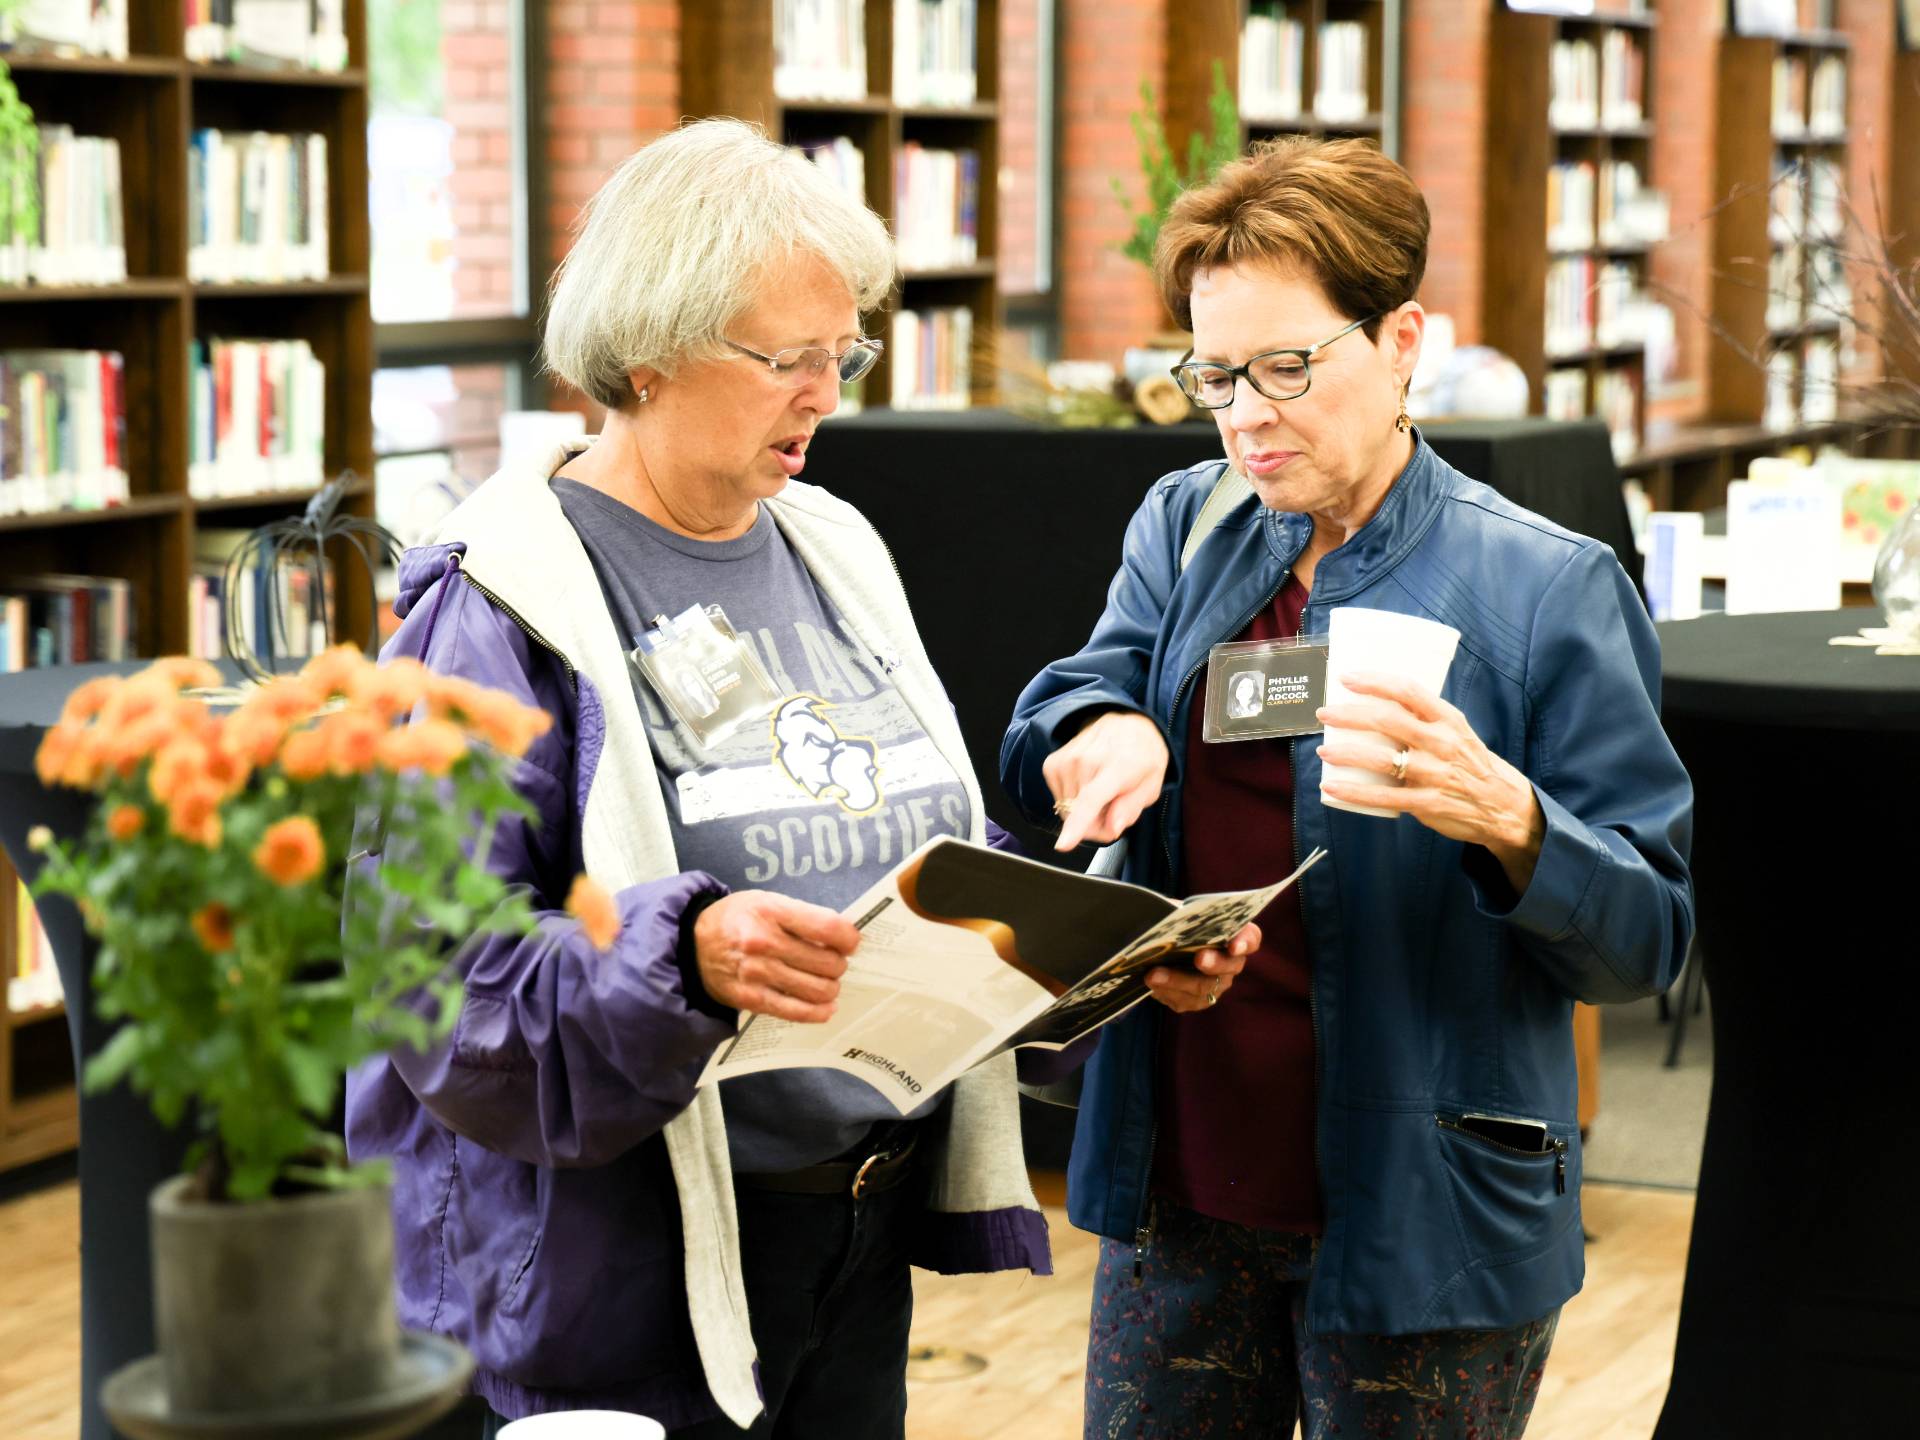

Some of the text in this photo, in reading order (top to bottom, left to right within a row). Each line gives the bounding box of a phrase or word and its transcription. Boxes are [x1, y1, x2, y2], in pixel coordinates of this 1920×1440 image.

[1268, 676, 1309, 685] PHYLLIS
[1267, 685, 1305, 694] (POTTER)
[1267, 692, 1309, 701] ADCOCK
[743, 793, 964, 882] SCOTTIES
[861, 1051, 922, 1093] HIGHLAND
